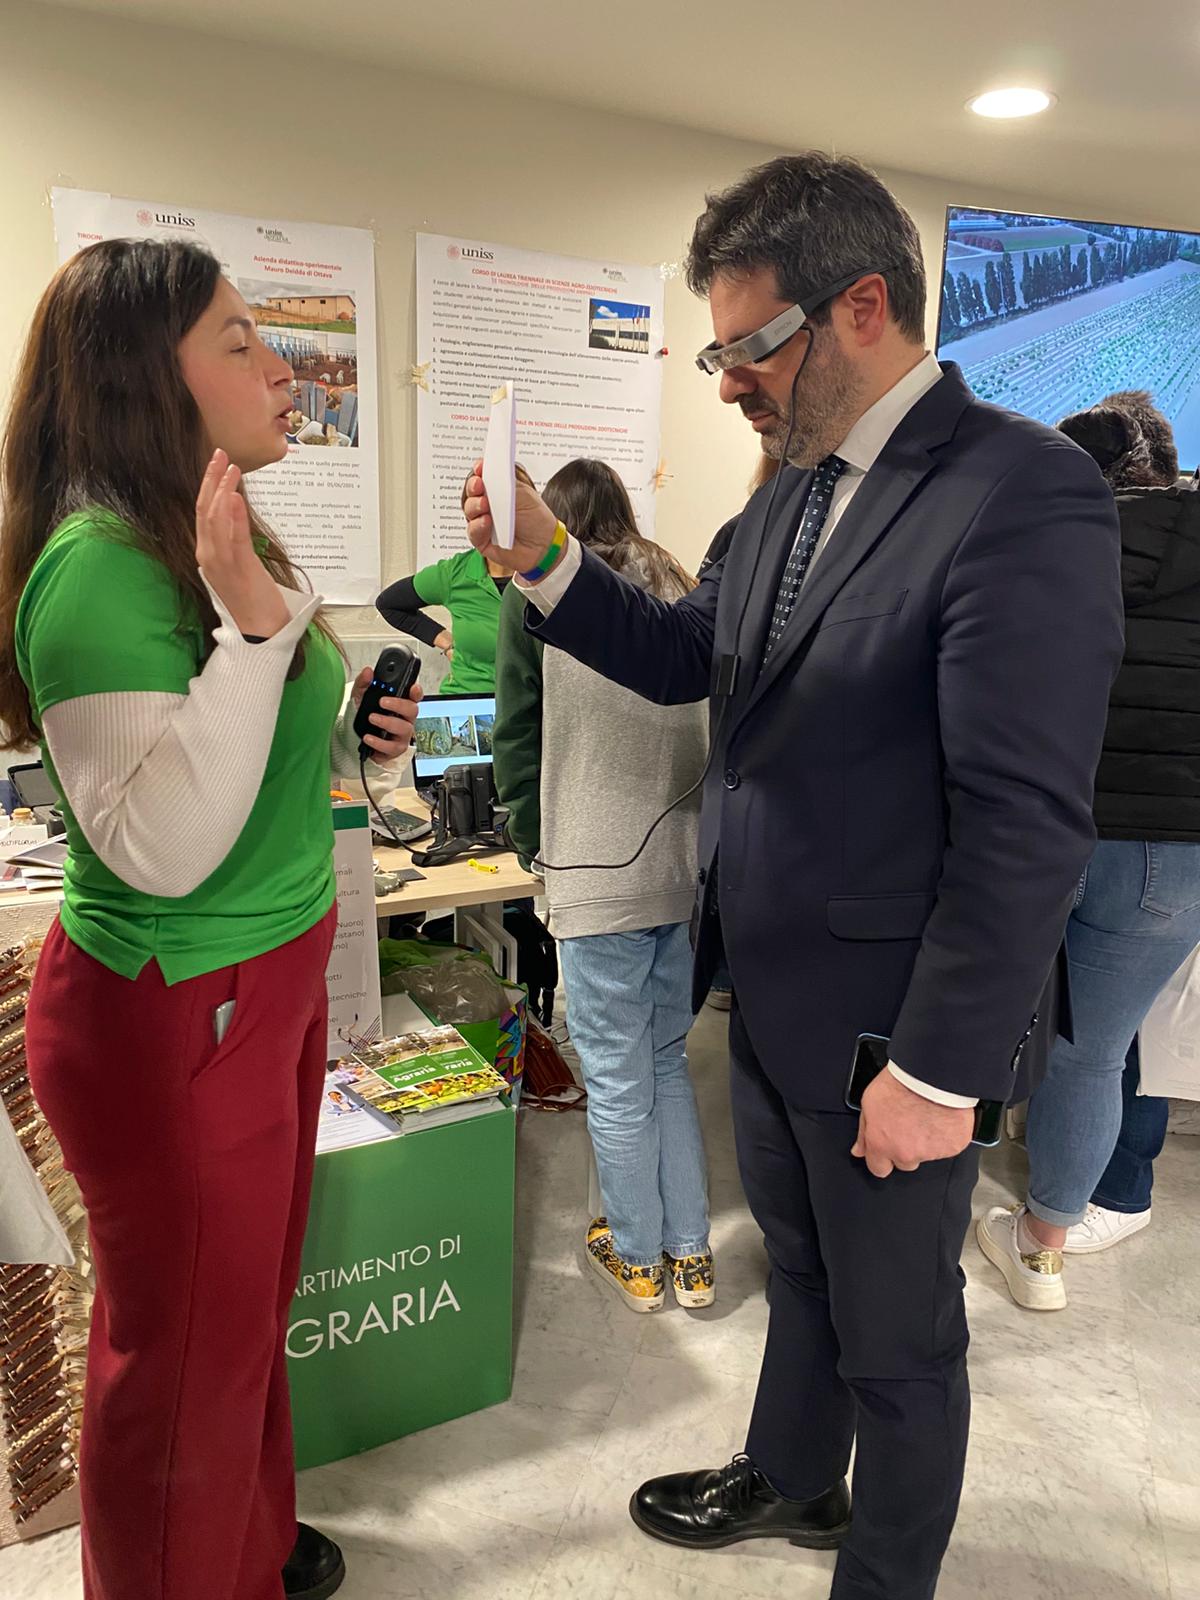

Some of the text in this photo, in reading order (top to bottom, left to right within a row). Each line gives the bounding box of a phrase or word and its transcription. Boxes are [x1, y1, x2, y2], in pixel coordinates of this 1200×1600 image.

[155, 213, 195, 227] uniss
[461, 247, 494, 260] uniss
[278, 258, 342, 271] didattico-sperimentale
[285, 267, 305, 276] Deidda
[336, 868, 352, 876] mali
[336, 889, 360, 898] ultura
[335, 930, 365, 939] ristano)
[444, 1059, 473, 1071] raria
[393, 1065, 436, 1082] Agraria
[439, 1234, 460, 1259] DI
[285, 1279, 462, 1359] GRARIA
